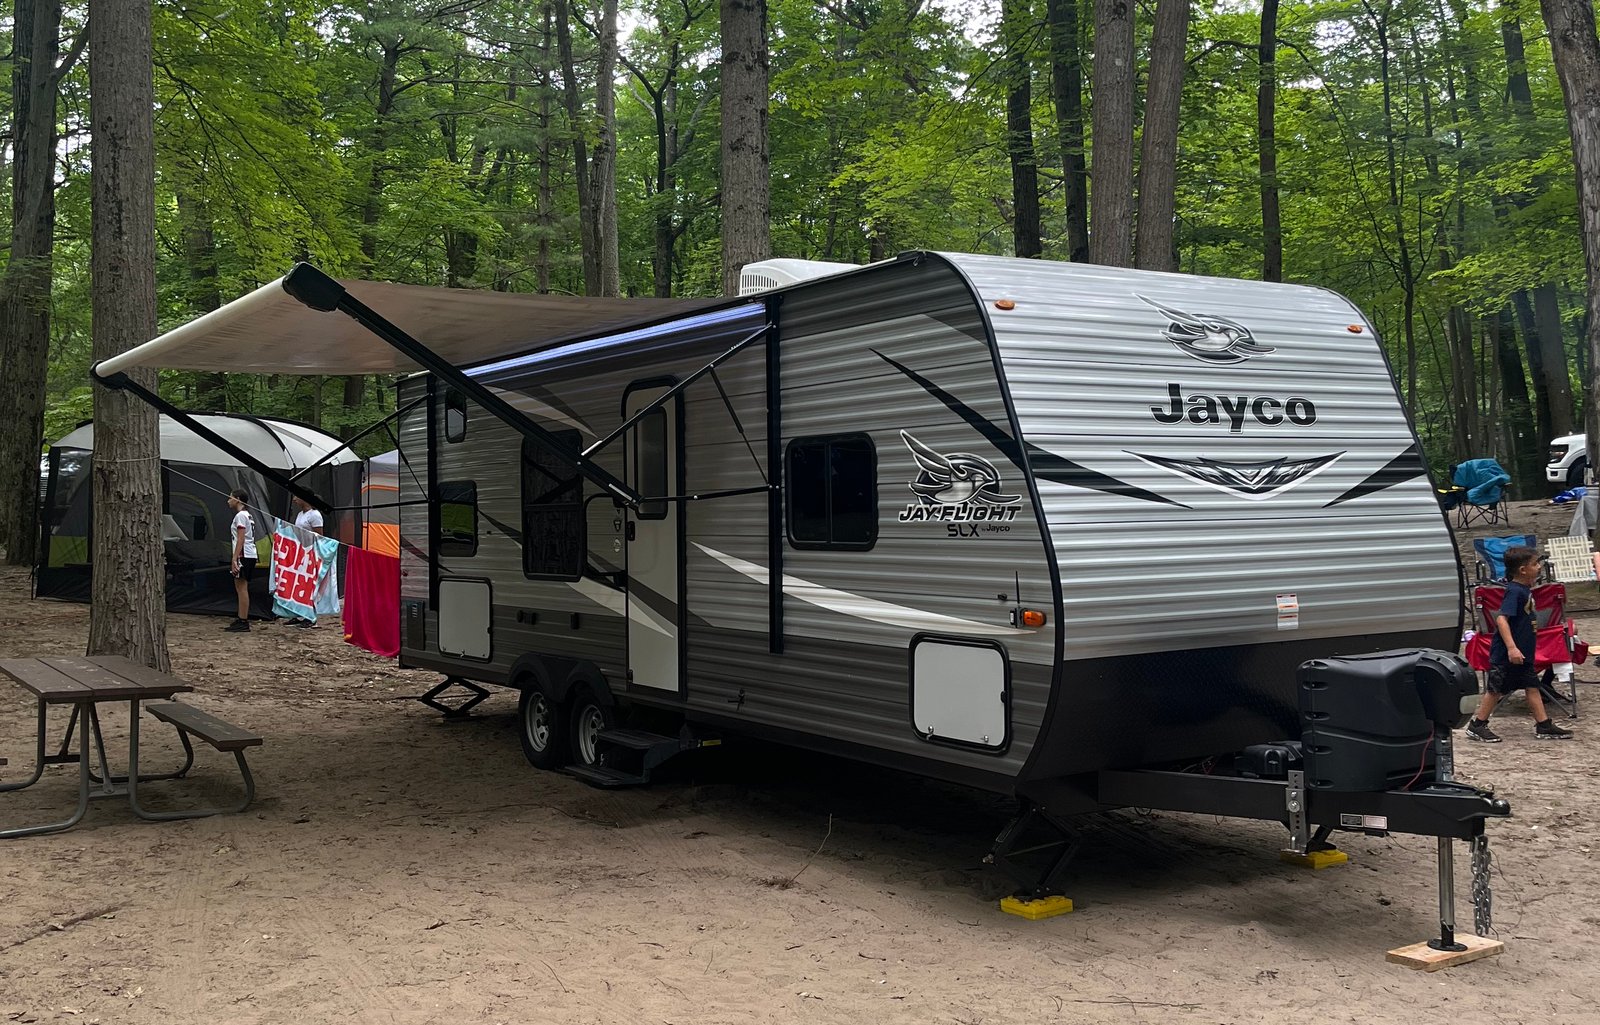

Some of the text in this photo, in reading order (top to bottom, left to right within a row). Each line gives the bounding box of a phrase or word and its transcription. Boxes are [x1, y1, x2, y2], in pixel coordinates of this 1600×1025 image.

[1150, 382, 1318, 434] Jayco
[898, 504, 1023, 522] JAY FLIGHT
[946, 523, 980, 537] SLX
[986, 524, 1011, 533] Jayco
